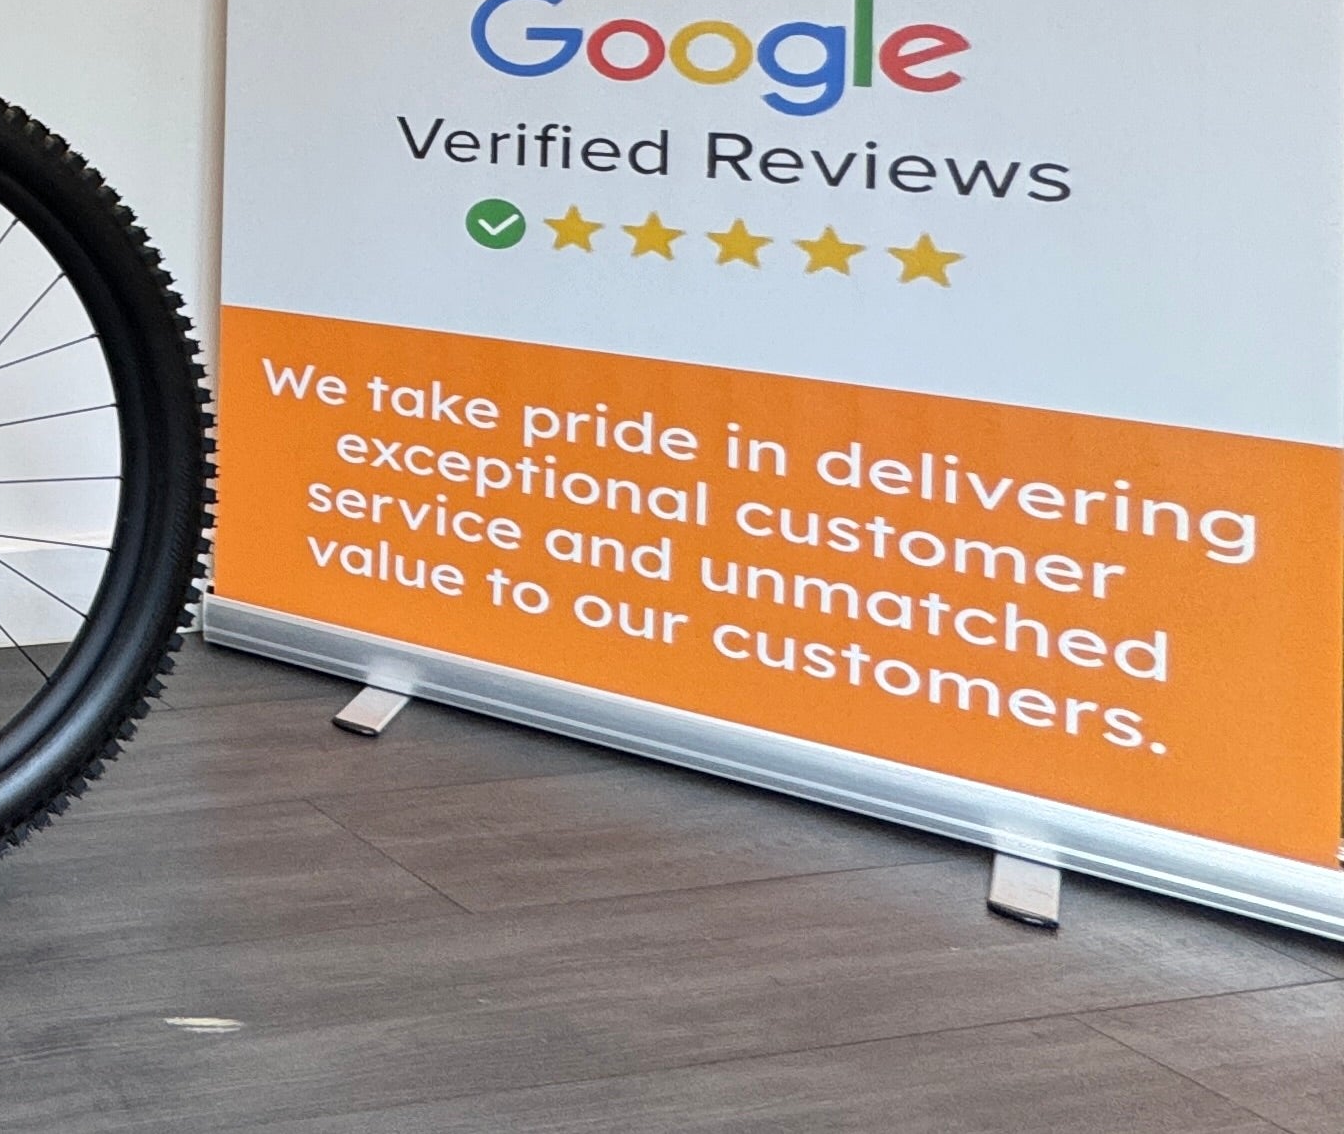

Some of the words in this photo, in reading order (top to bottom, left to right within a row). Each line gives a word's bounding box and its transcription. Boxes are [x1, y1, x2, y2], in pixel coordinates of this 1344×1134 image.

[397, 117, 668, 175] Verified
[705, 133, 1070, 201] Reviews
[263, 359, 347, 405] We
[368, 377, 499, 429] take
[523, 404, 698, 461] pride
[728, 423, 787, 476] in
[816, 442, 1257, 565] delivering
[337, 434, 708, 526] exceptional
[736, 502, 1126, 599] customer
[308, 483, 522, 550] service
[545, 529, 672, 581] and
[701, 557, 1168, 682] unmatched
[308, 537, 465, 596] value
[486, 569, 550, 614] to
[573, 595, 688, 644] our
[713, 624, 1167, 755] customers.
